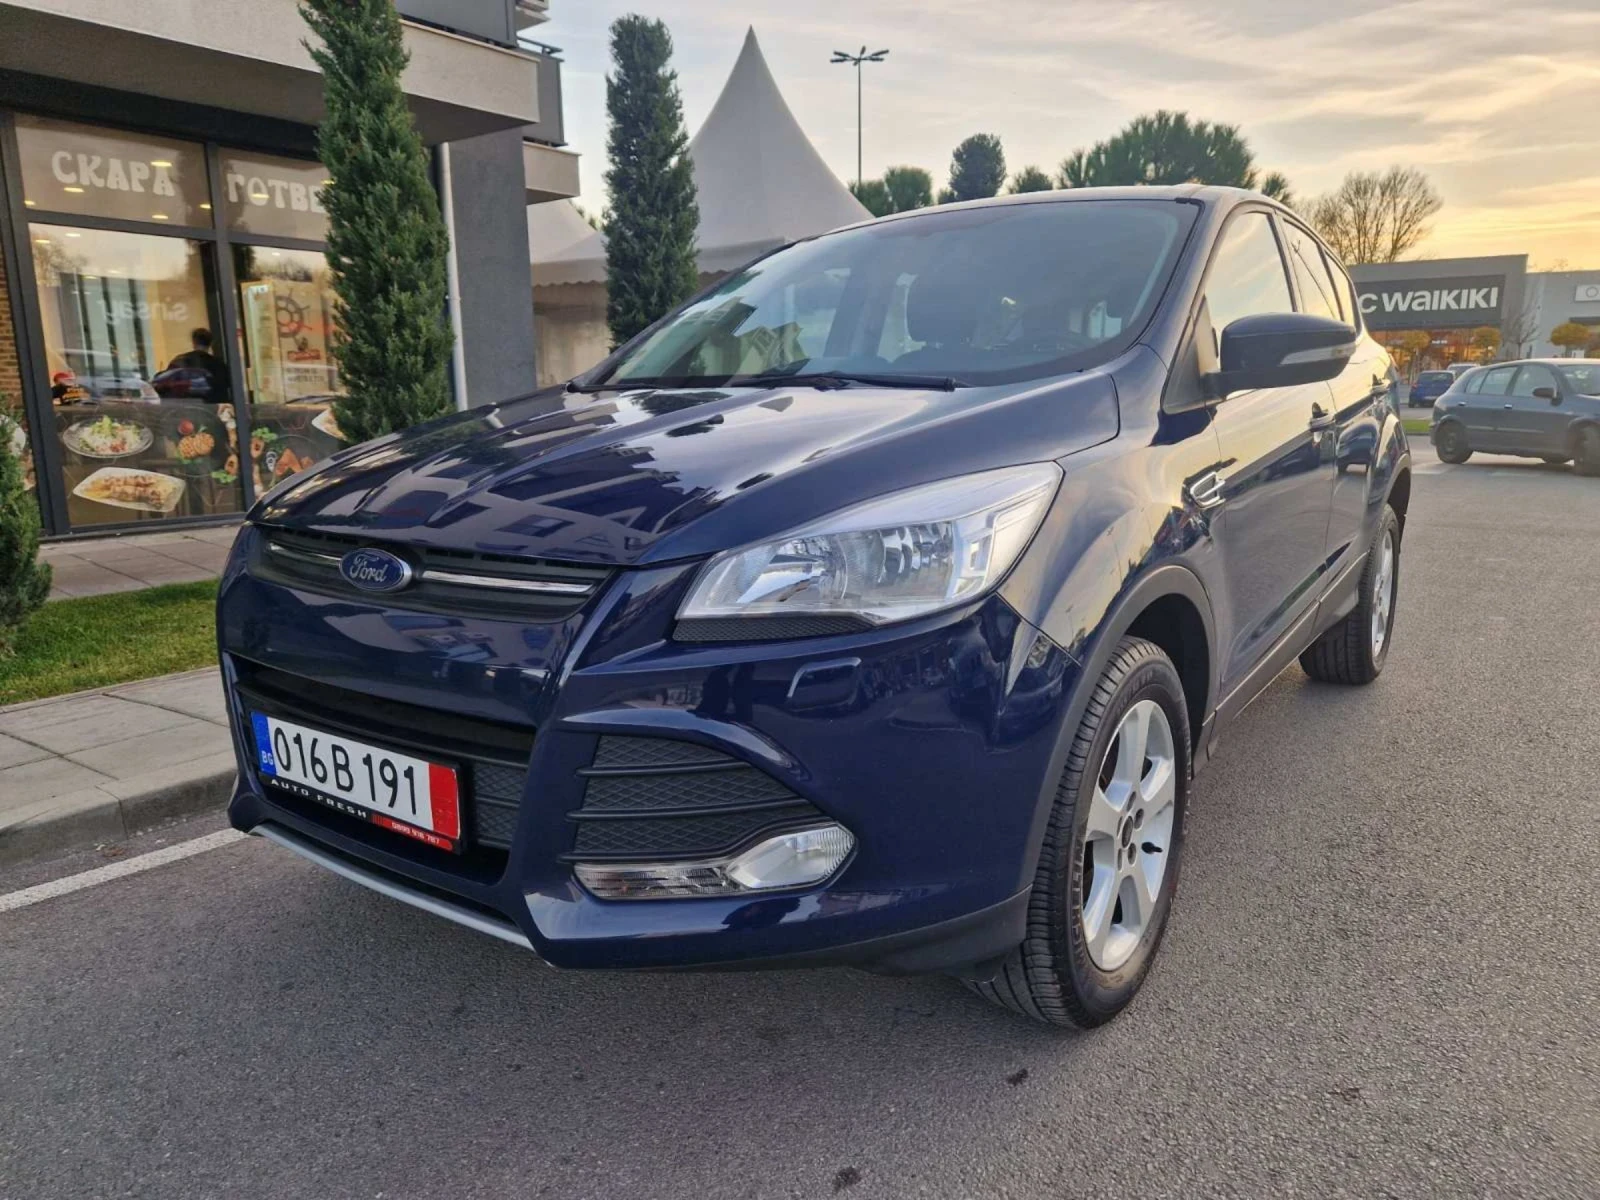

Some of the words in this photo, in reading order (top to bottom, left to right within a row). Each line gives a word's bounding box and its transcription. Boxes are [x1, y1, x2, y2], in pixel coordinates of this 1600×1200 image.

[52, 151, 175, 196] СКАРА
[349, 553, 389, 583] Ford
[261, 750, 275, 766] BG
[271, 779, 309, 796] AUTO
[317, 795, 367, 818] FRESH
